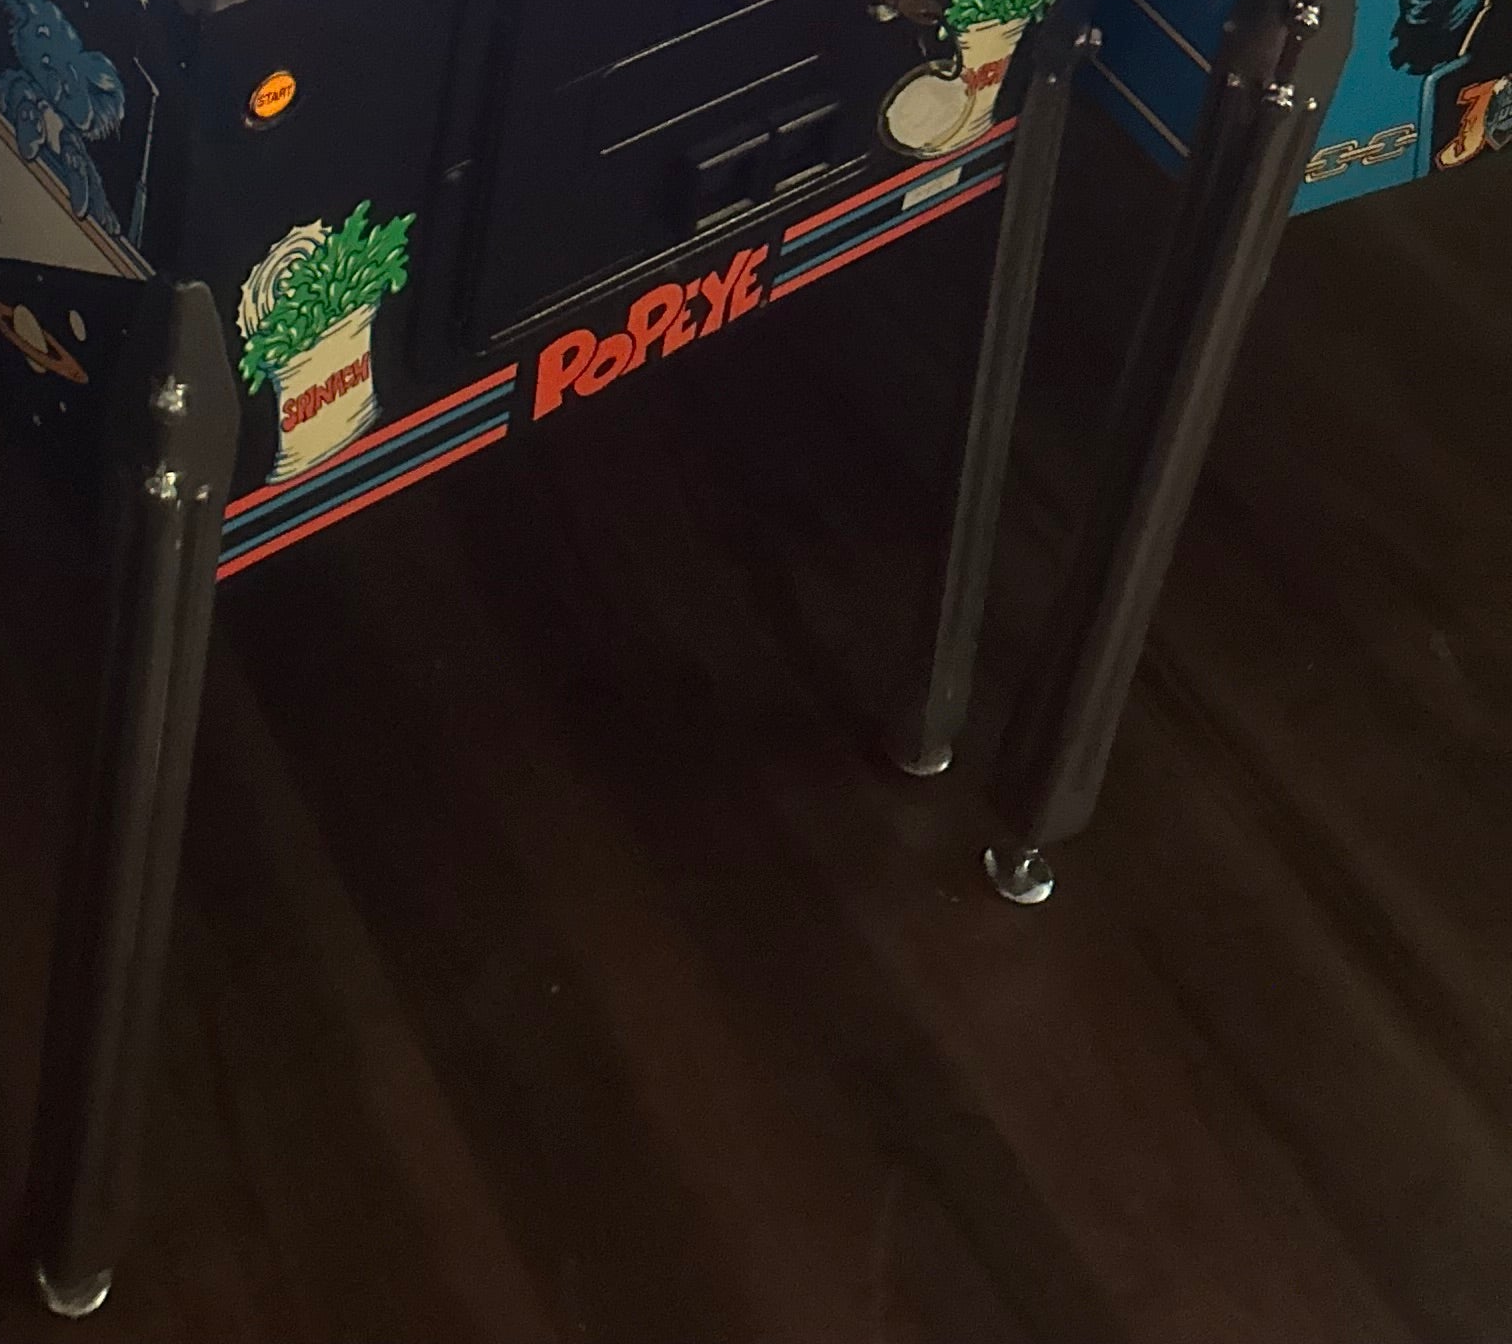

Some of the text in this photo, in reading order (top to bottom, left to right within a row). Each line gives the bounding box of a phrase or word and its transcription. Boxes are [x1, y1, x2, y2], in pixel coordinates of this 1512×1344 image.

[256, 82, 293, 108] START
[533, 243, 770, 422] POPEYE
[280, 350, 372, 434] SPINACH
